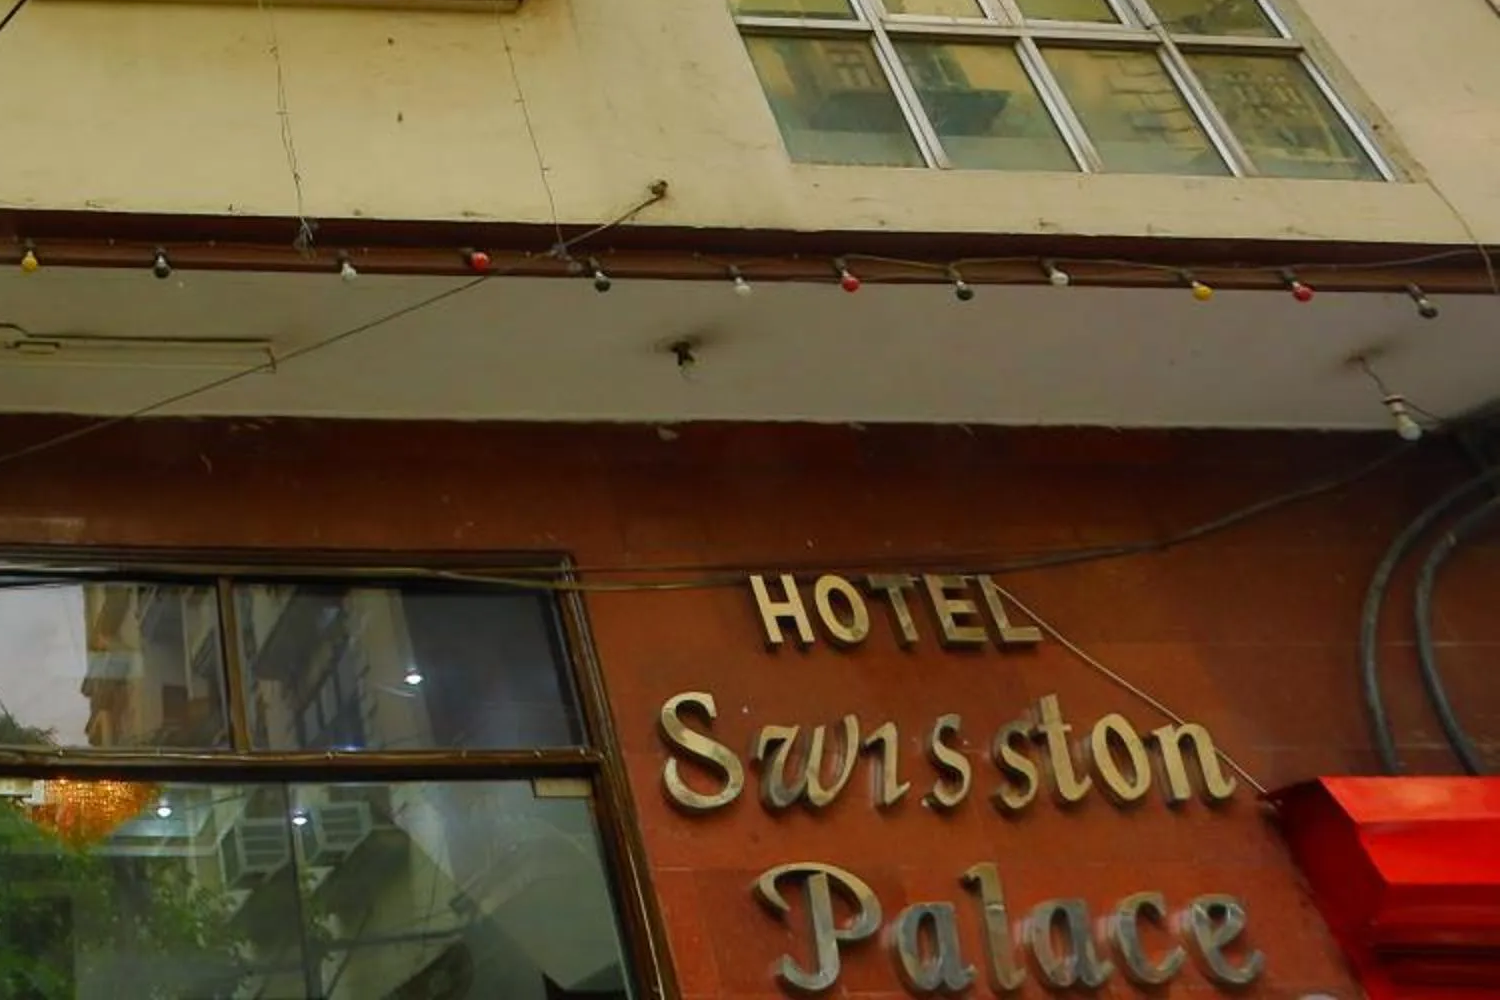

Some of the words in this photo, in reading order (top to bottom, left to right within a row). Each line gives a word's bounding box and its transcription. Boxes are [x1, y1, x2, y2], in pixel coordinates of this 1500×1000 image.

[748, 573, 1042, 648] HOTEL
[658, 691, 1237, 810] Swisston
[752, 861, 1265, 992] Palace
